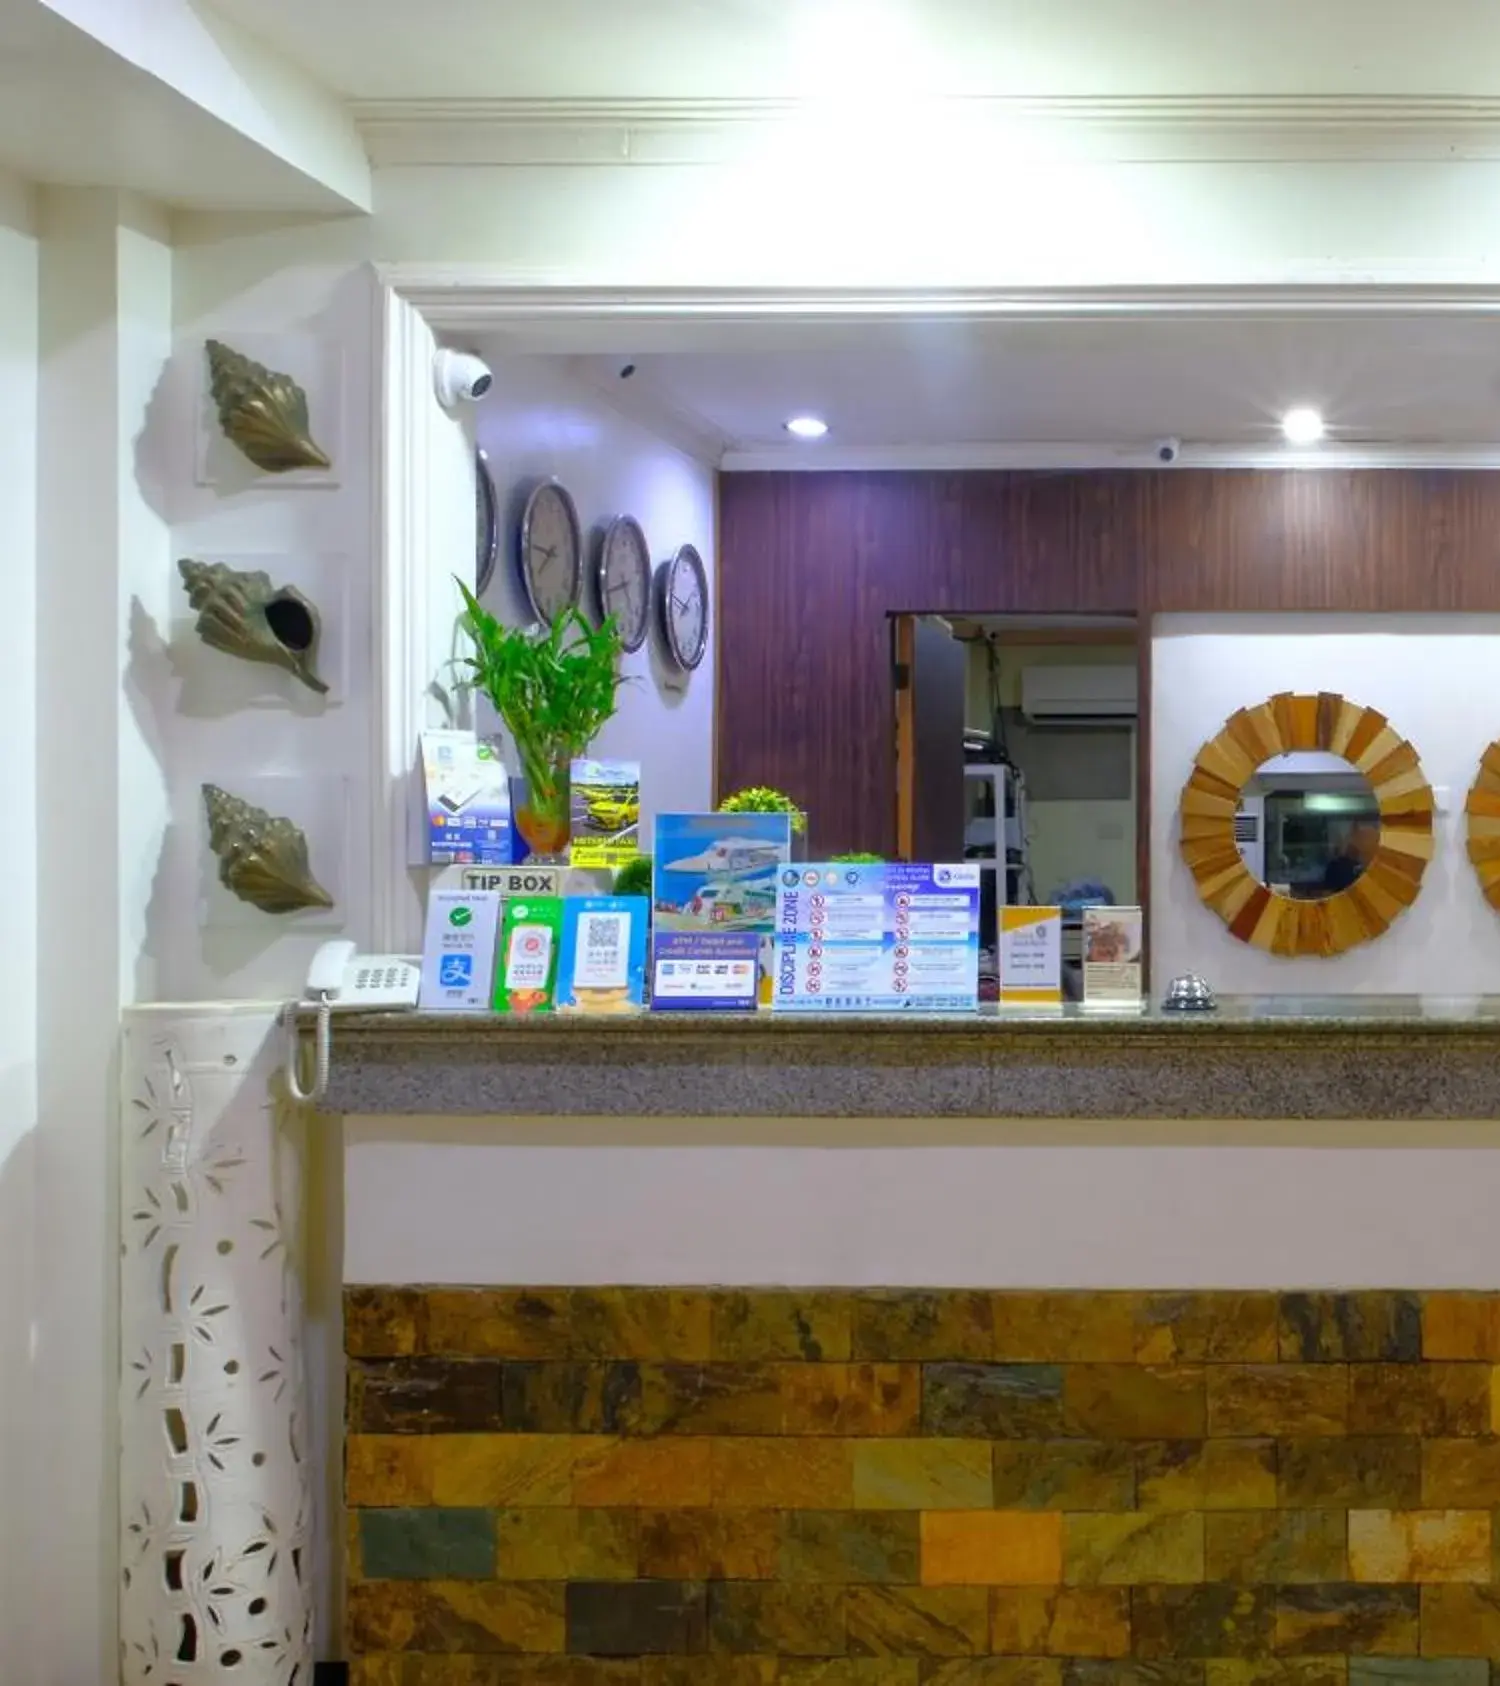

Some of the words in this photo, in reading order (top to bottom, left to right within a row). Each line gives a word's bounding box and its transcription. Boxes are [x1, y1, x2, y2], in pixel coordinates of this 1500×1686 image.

[466, 875, 501, 890] TIP
[508, 875, 552, 891] BOX
[783, 891, 799, 925] ZONE
[780, 927, 797, 995] DISCIPLINE
